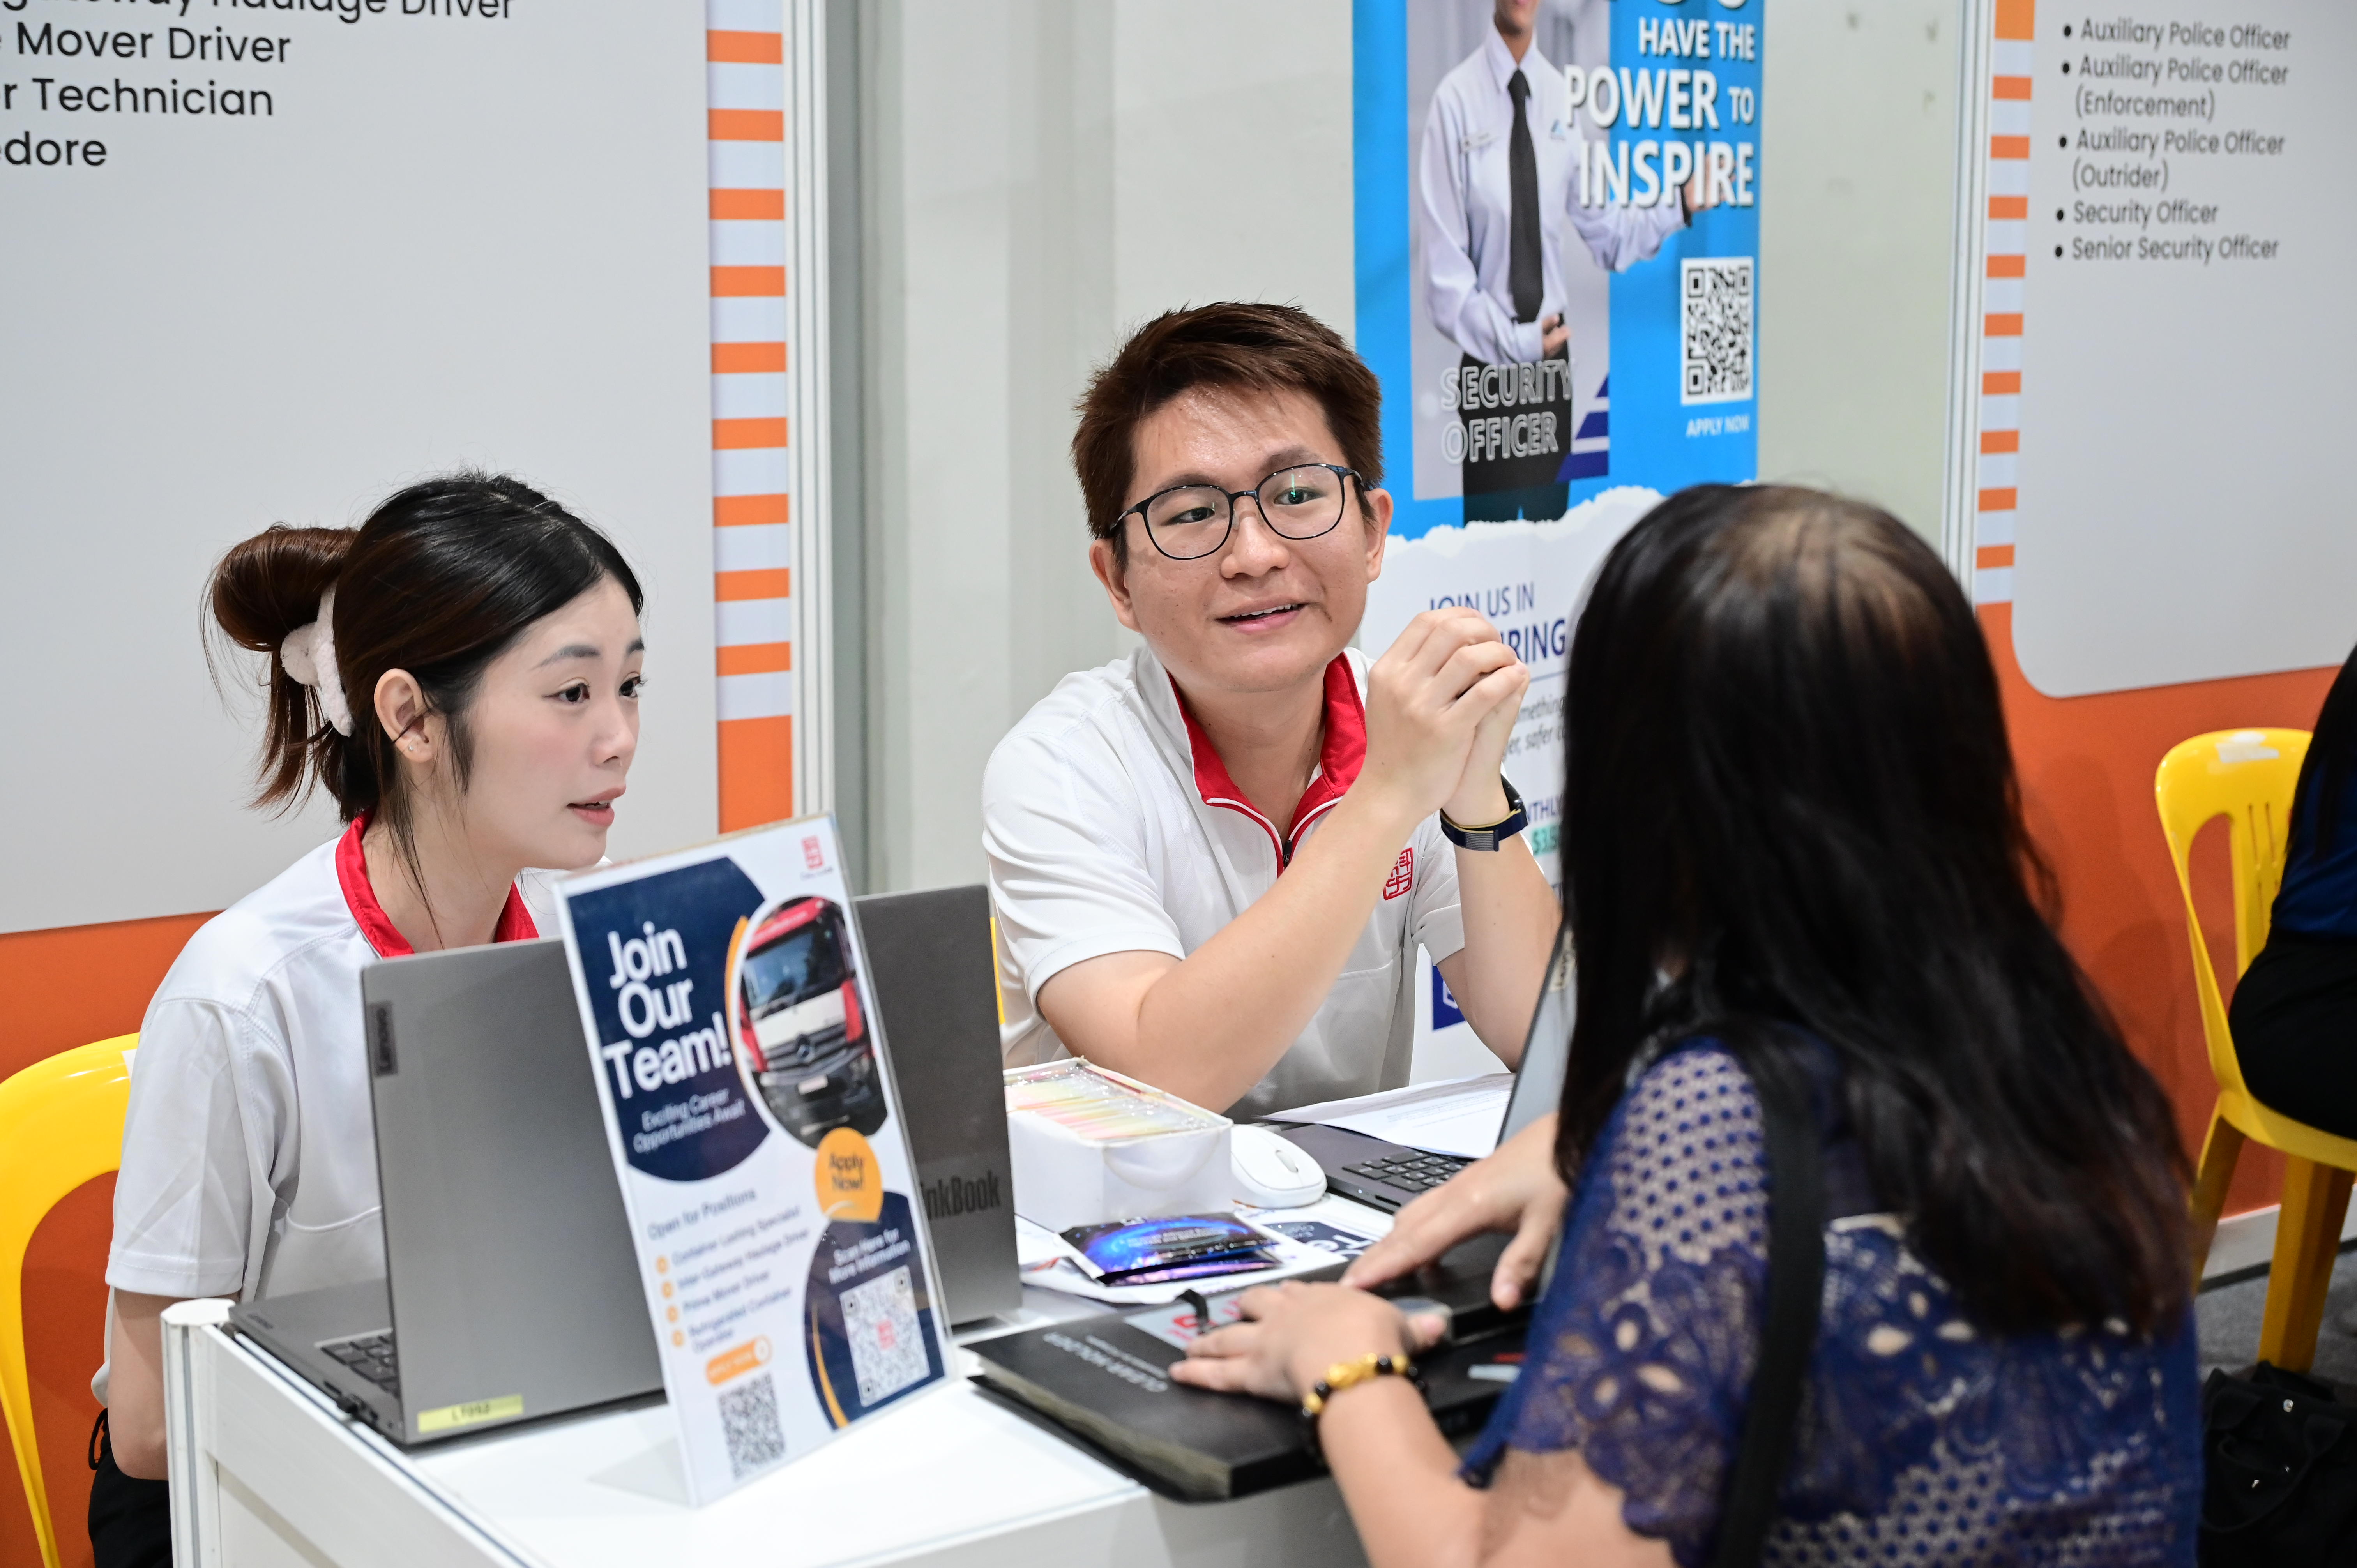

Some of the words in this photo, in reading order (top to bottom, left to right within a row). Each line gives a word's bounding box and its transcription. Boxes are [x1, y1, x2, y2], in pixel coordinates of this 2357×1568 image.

[17, 22, 153, 58] Mover
[169, 26, 291, 62] Driver
[1639, 17, 1709, 57] HAVE
[1716, 22, 1754, 61] THE
[2080, 18, 2164, 51] Auxiliary
[2170, 22, 2225, 48] Police
[2230, 25, 2290, 49] Officer
[2078, 55, 2162, 87] Auxiliary
[2168, 57, 2223, 83] Police
[2228, 60, 2288, 85] Officer
[32, 78, 272, 116] Technician
[1564, 64, 1719, 129] POWER
[1728, 87, 1754, 124] TO
[2076, 83, 2215, 122] (Enforcement)
[0, 131, 106, 166] dore
[2076, 128, 2159, 161] Auxiliary
[2164, 130, 2219, 154] Police
[2224, 131, 2285, 155] Officer
[1580, 139, 1754, 208] INSPIRE
[2073, 157, 2169, 192] (Outrider)
[2074, 200, 2152, 230] Security
[2157, 200, 2218, 224] Officer
[2073, 236, 2133, 260] Senior
[2138, 236, 2214, 266] Security
[2219, 236, 2279, 259] Officer
[1441, 359, 1573, 411] SECURITY
[1442, 411, 1559, 464] OFFICER
[1686, 418, 1723, 437] APPLY
[1724, 415, 1749, 433] NOW
[1488, 586, 1510, 616] US
[1517, 582, 1534, 611] IN
[1500, 618, 1566, 663] RING
[608, 921, 687, 989] Join
[618, 979, 694, 1038] Our
[602, 1012, 733, 1099] Team!
[642, 1102, 691, 1132] Exciting
[689, 1088, 729, 1115] Career
[829, 1153, 864, 1174] Apply
[920, 1169, 1001, 1221] nkBook
